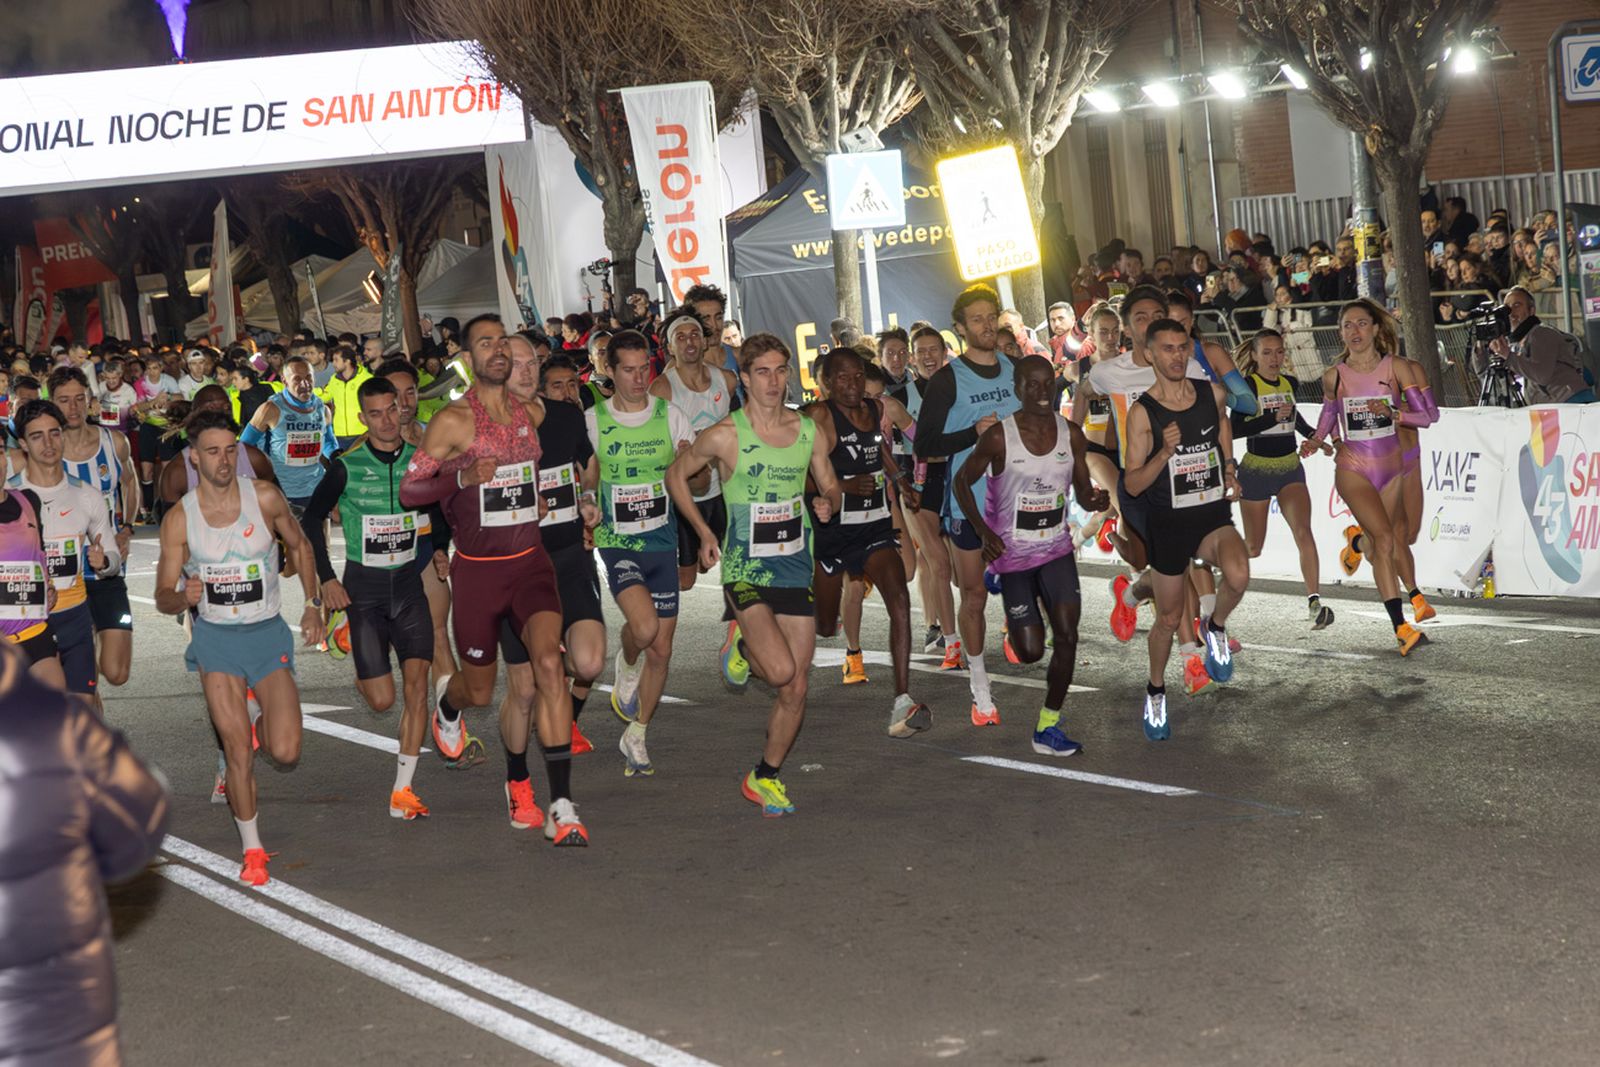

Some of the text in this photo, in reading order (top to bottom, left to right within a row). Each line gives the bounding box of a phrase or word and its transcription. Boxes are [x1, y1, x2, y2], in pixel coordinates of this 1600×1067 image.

[108, 106, 233, 145] NOCHE
[242, 101, 287, 132] DE
[303, 94, 374, 128] SAN
[382, 75, 503, 120] ANTÓN
[976, 238, 1016, 256] PASO
[967, 251, 1034, 275] ELEVADO
[970, 386, 1012, 404] nerja
[624, 438, 665, 450] Fundación
[1185, 442, 1212, 454] VICKY
[625, 447, 657, 458] Unicaja
[1426, 451, 1481, 493] XAVE
[1197, 480, 1206, 488] 12
[502, 486, 523, 498] Arce
[510, 496, 518, 506] 3
[547, 497, 557, 507] 23
[628, 500, 655, 512] Casas
[863, 499, 874, 508] 21
[638, 509, 647, 517] 19
[1533, 474, 1566, 545] 43
[1037, 518, 1049, 526] 22
[777, 530, 788, 540] 28
[388, 542, 398, 550] 13
[7, 581, 37, 593] Gaitán
[213, 582, 253, 594] Cantero
[18, 592, 29, 602] 10
[230, 592, 238, 602] 7
